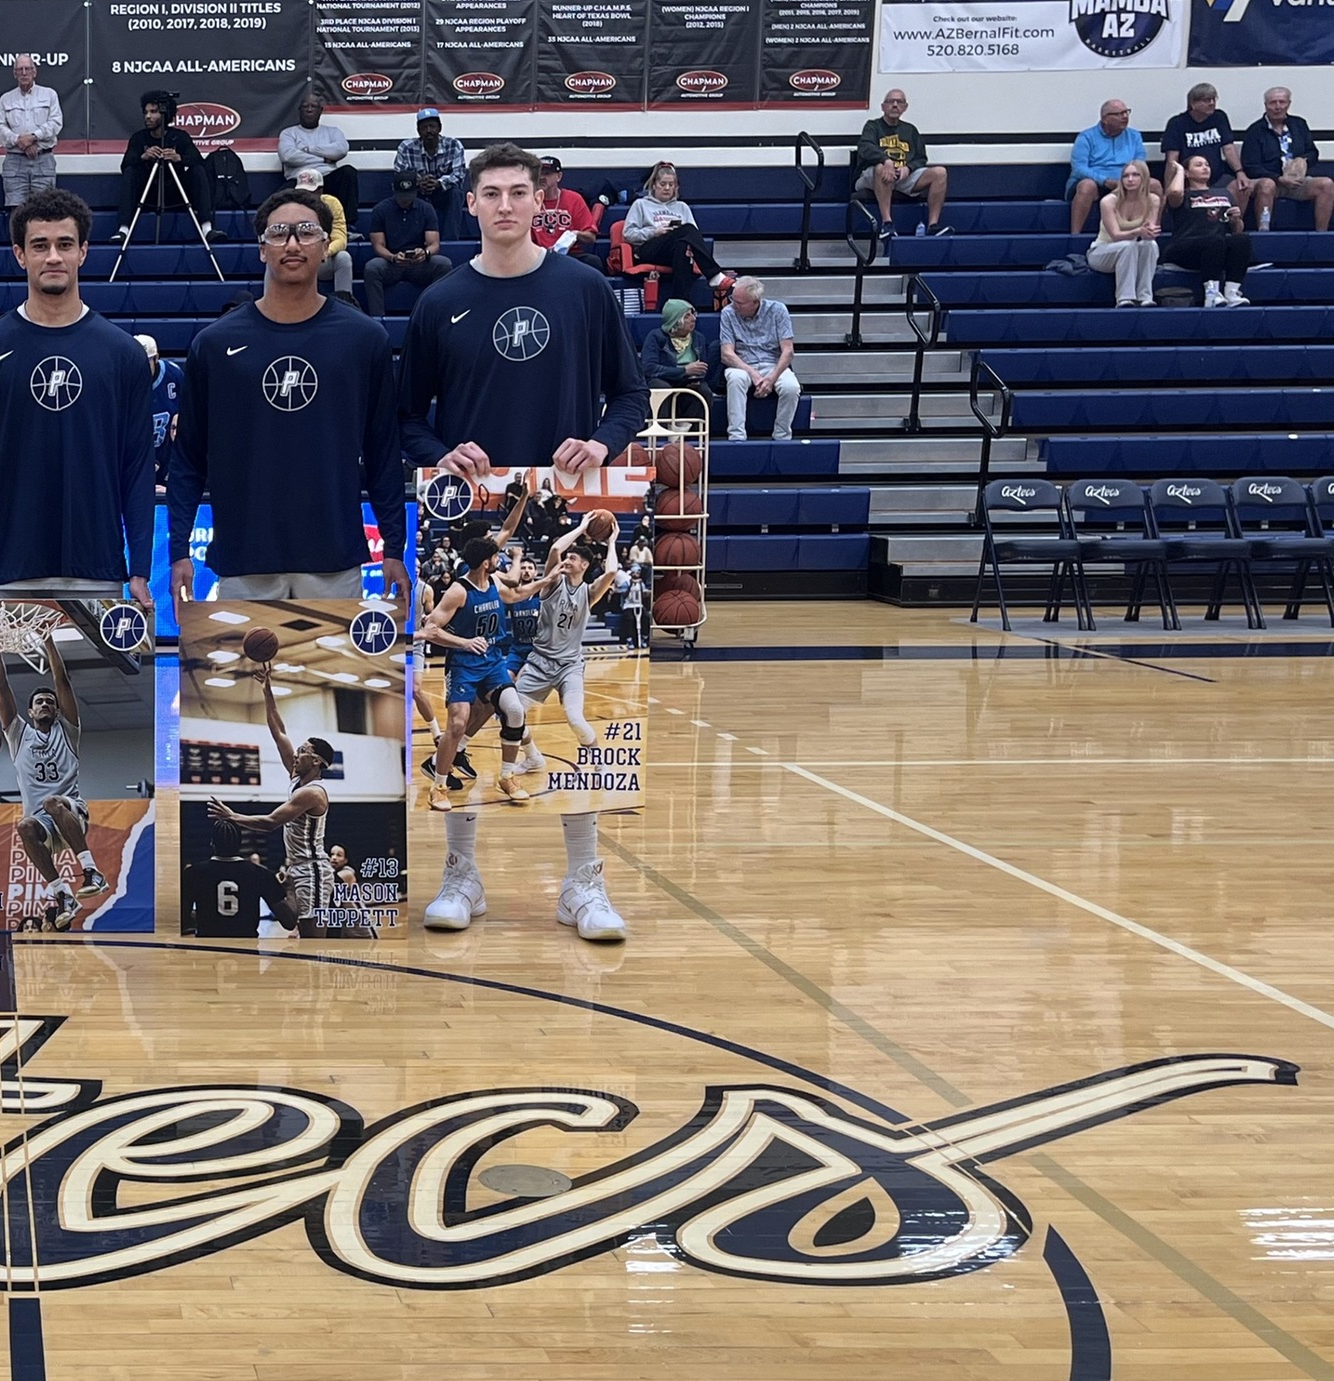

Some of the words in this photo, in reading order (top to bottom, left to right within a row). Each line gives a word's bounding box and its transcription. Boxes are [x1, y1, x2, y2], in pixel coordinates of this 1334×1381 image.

[110, 4, 159, 16] REGION
[162, 4, 168, 16] I,
[171, 4, 227, 16] DIVISION
[230, 4, 237, 16] II
[240, 4, 281, 16] TITLES
[128, 18, 164, 31] (2010,
[167, 18, 198, 31] 2017,
[200, 18, 231, 31] 2018,
[233, 18, 267, 31] 2019)
[893, 27, 1055, 40] www.AZBernalFit.com
[1102, 13, 1136, 38] AZ
[927, 44, 1019, 56] 520.820.5168
[111, 59, 121, 73] 8
[124, 59, 173, 73] NJCAA
[176, 59, 296, 73] ALL-AMERICANS
[175, 114, 234, 126] HAPMAN
[532, 212, 571, 229] GCC
[512, 319, 529, 348] P
[48, 370, 66, 397] P
[280, 371, 301, 397] P
[1001, 485, 1036, 505] Aztecs
[1085, 485, 1120, 505] Aztecs
[1167, 484, 1201, 504] Aztecs
[1248, 483, 1282, 503] Aztecs
[475, 611, 499, 637] 50
[557, 612, 574, 629] 21
[604, 722, 641, 741] #21
[577, 748, 641, 766] BROCK
[34, 762, 59, 782] 33
[548, 773, 641, 791] MENDOZA
[360, 858, 399, 879] #13
[217, 881, 239, 916] 6
[333, 883, 398, 903] MASON
[314, 907, 399, 929] TIPPETT
